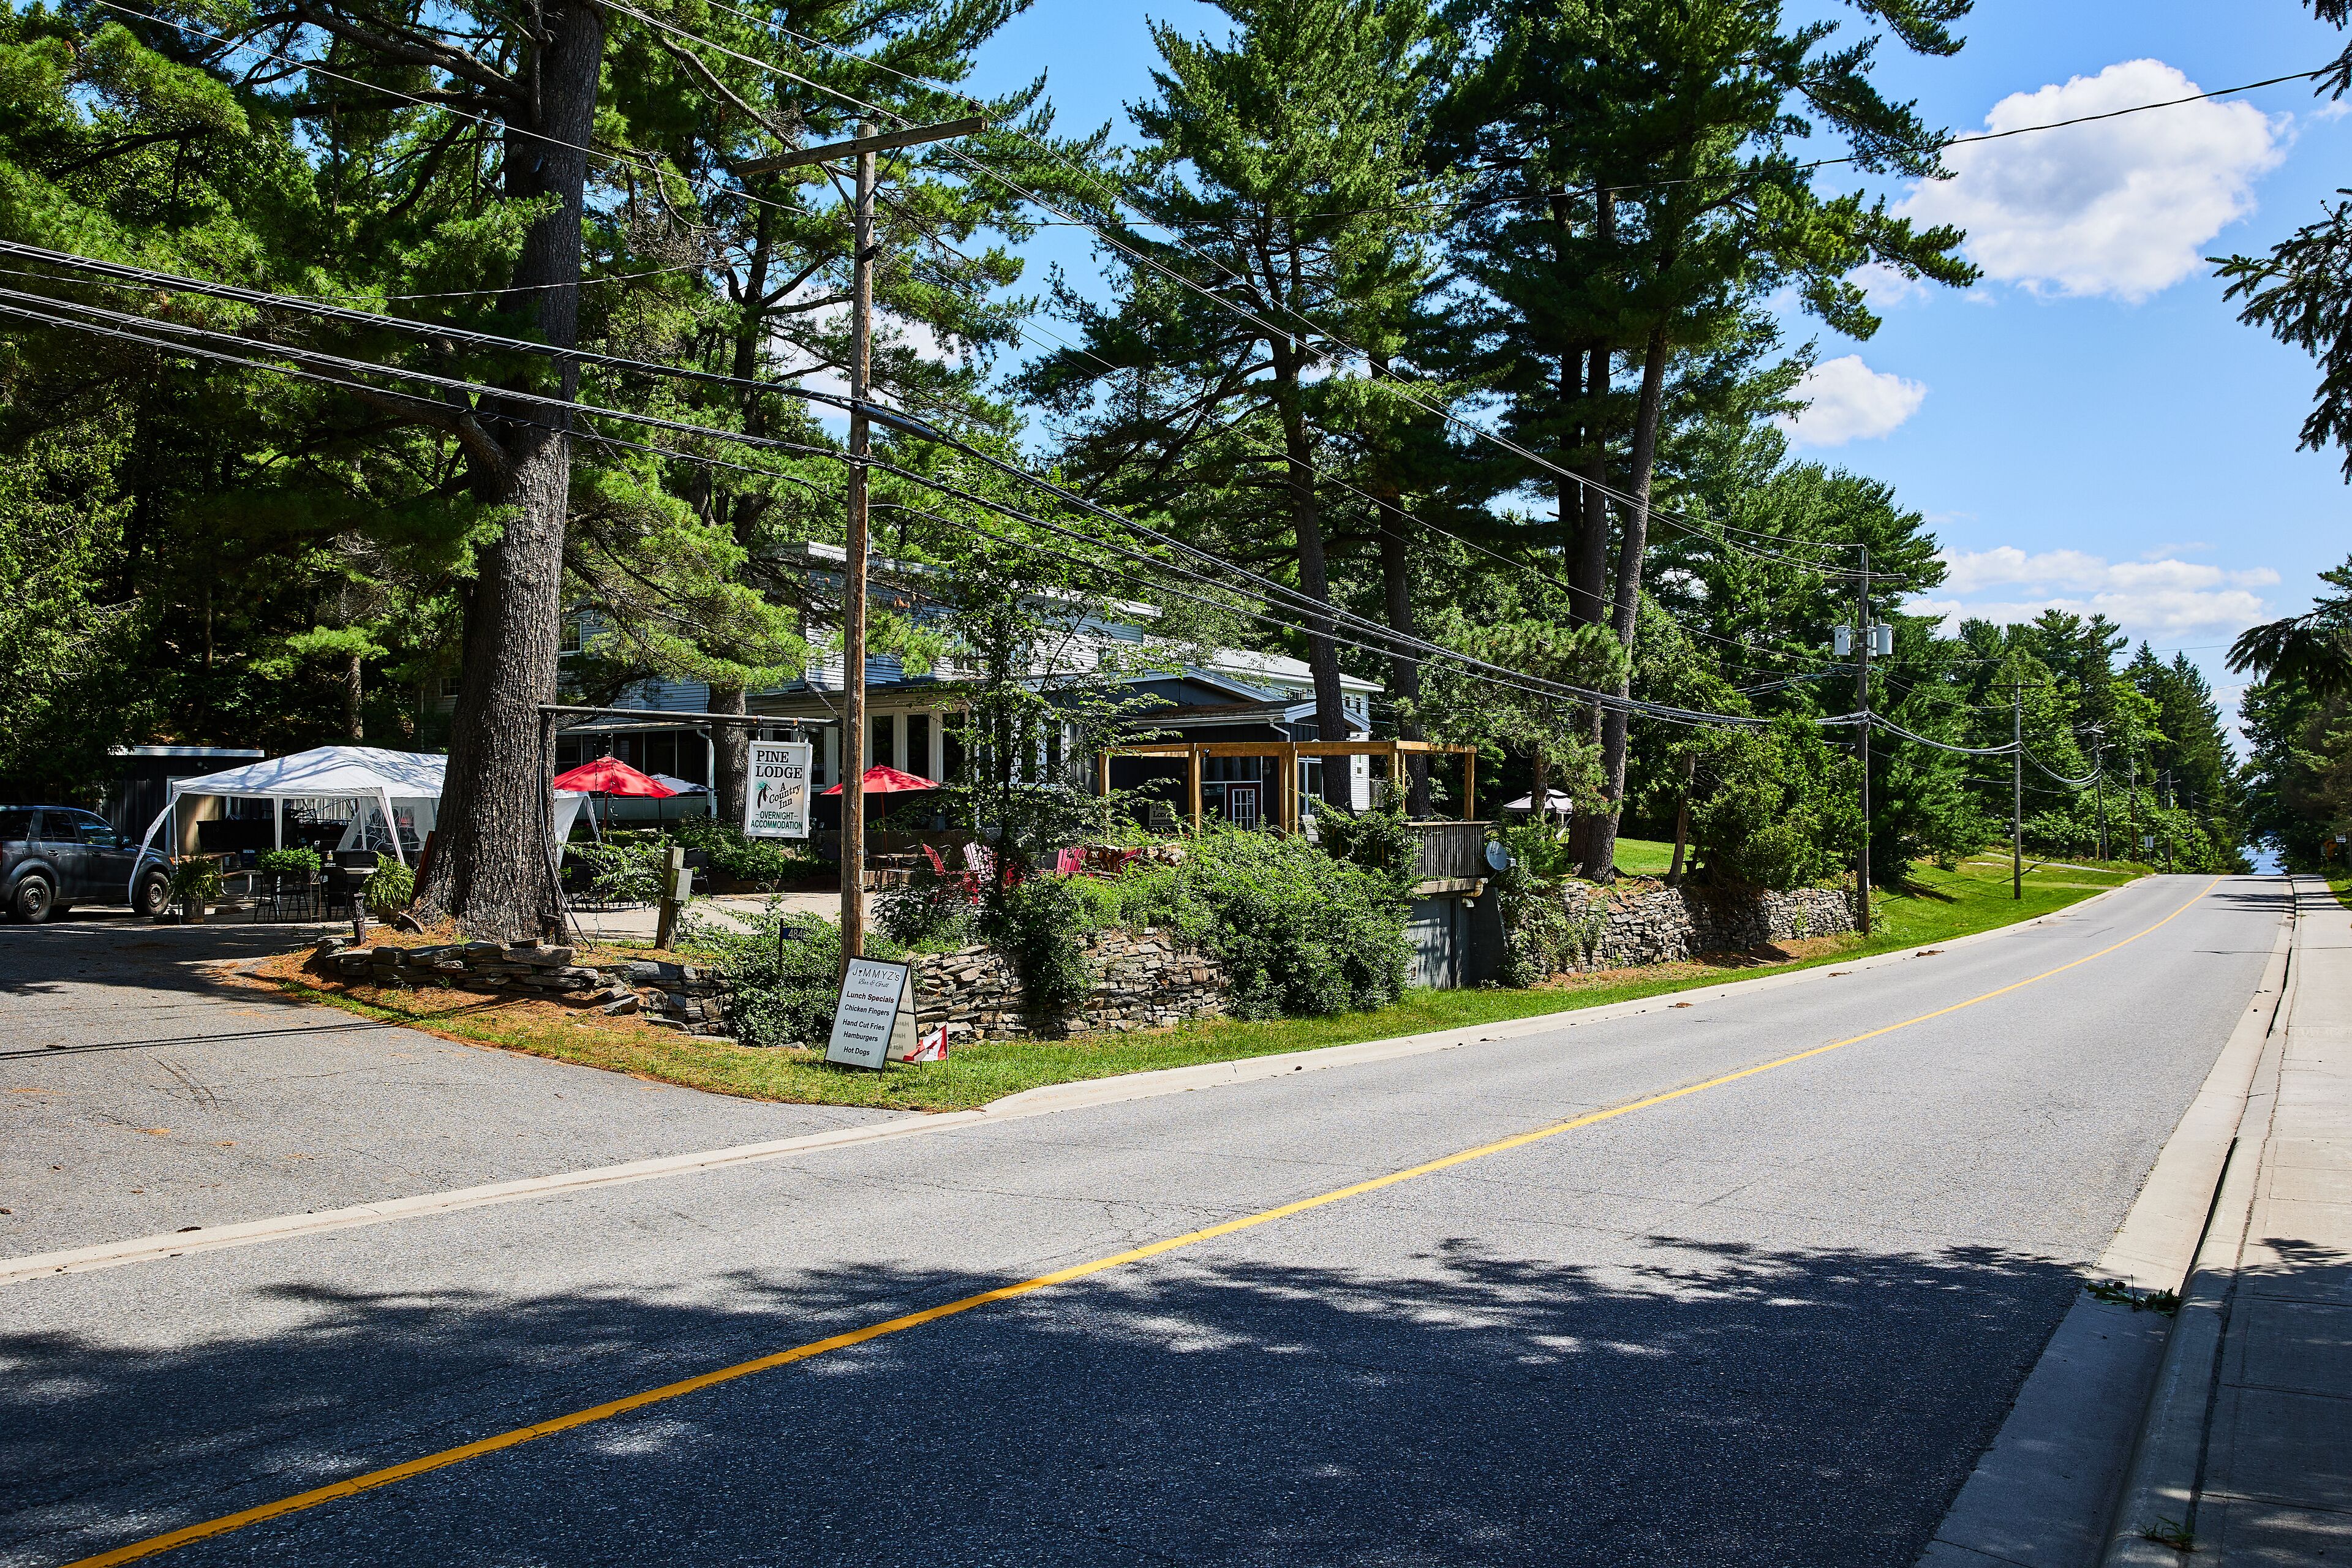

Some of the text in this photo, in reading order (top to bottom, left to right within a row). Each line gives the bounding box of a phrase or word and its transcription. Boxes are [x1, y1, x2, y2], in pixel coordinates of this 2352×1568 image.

[756, 750, 789, 763] PINE
[755, 766, 802, 778] LODGE
[780, 782, 786, 793] A
[769, 784, 801, 804] Country
[778, 797, 793, 810] Inn
[751, 820, 802, 829] ACCOMMODATION
[788, 929, 802, 939] 484
[846, 990, 866, 1000] Lunch
[867, 993, 894, 1003] Specials
[845, 1005, 889, 1017] Chicken Fingers
[843, 1019, 858, 1028] Hand
[859, 1020, 870, 1029] Cut
[843, 1031, 878, 1041] Hamburgers
[855, 1047, 870, 1056] Dogs
